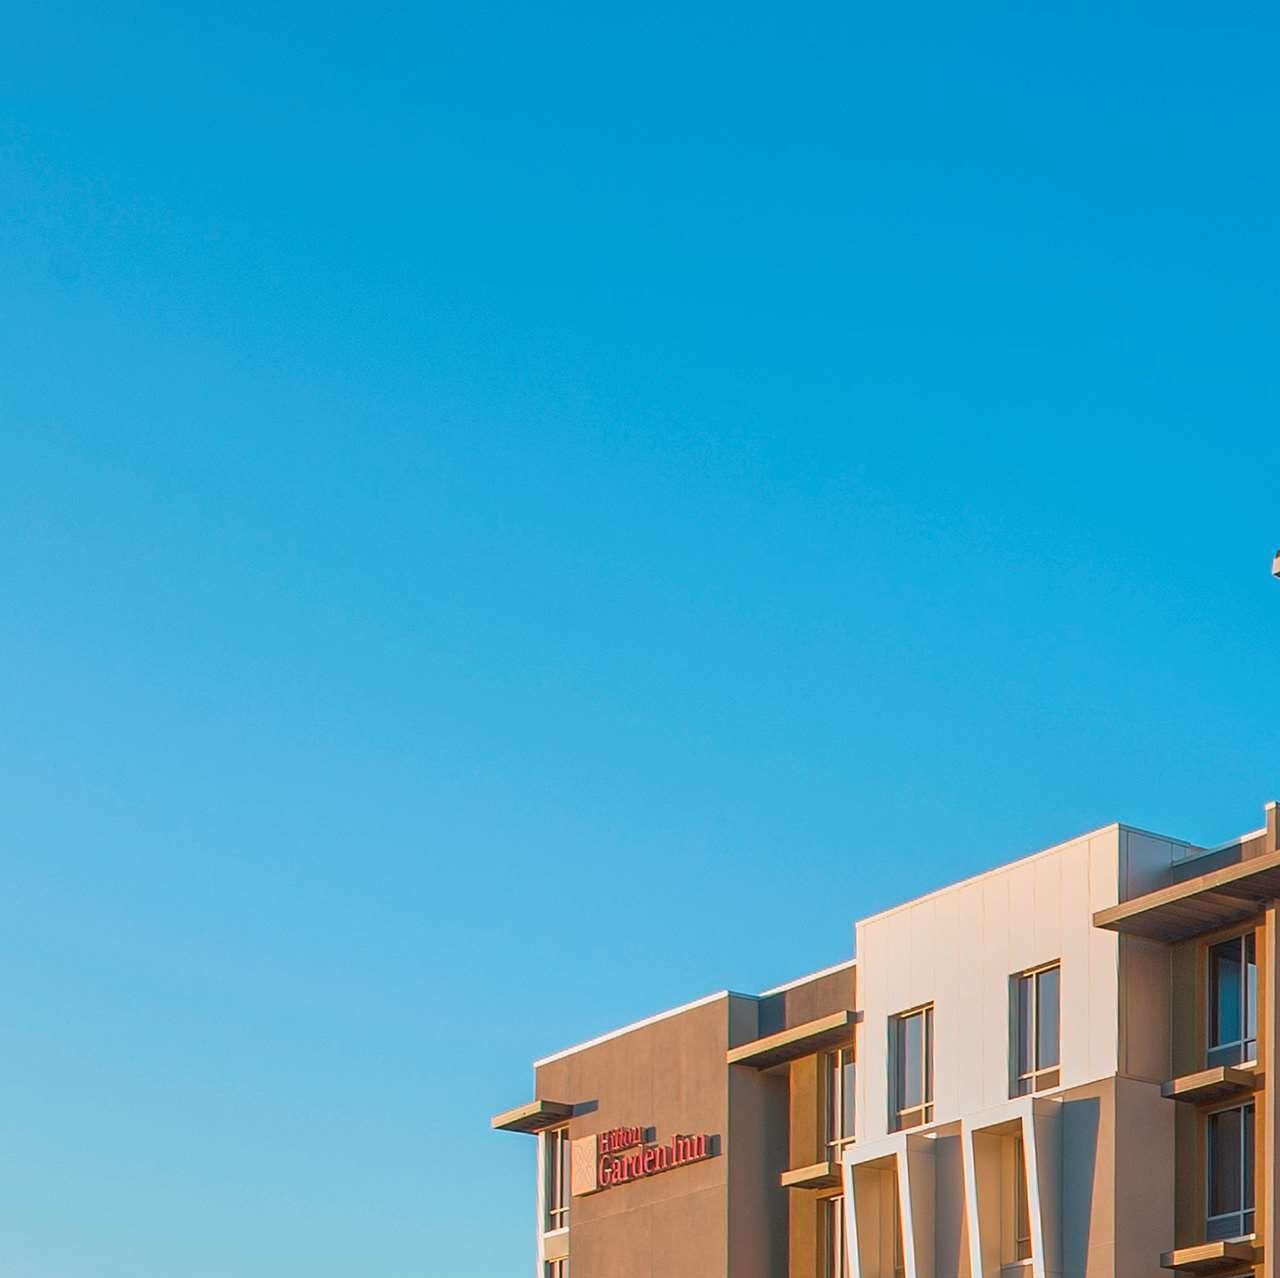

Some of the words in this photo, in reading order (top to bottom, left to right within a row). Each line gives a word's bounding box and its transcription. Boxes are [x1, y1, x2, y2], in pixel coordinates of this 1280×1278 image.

[600, 1126, 642, 1153] Hilton
[600, 1143, 667, 1187] Garden
[671, 1133, 706, 1166] Inn
